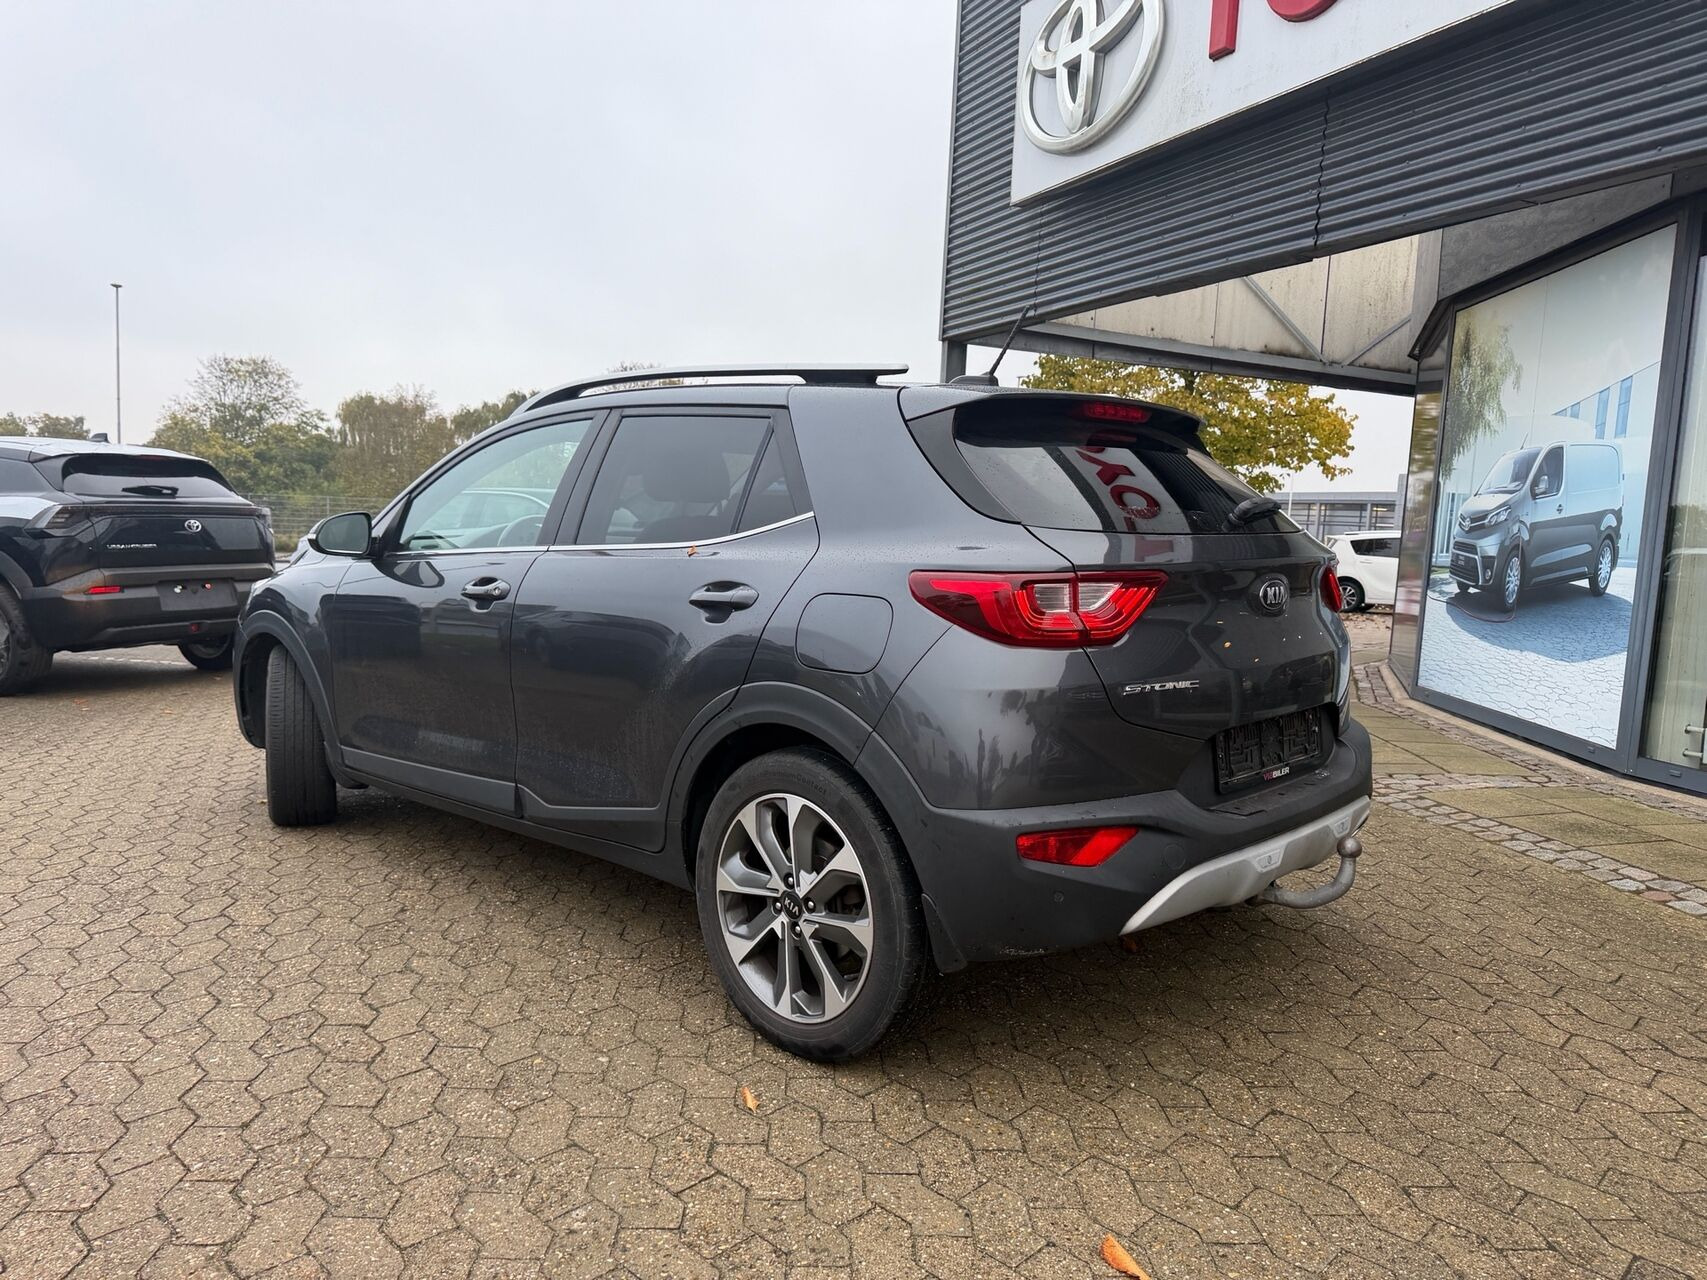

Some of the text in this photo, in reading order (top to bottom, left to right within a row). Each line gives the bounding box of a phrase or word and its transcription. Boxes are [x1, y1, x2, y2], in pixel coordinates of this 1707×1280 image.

[1266, 585, 1287, 605] KIA
[1122, 679, 1200, 696] STONIC
[784, 896, 799, 917] KIA
